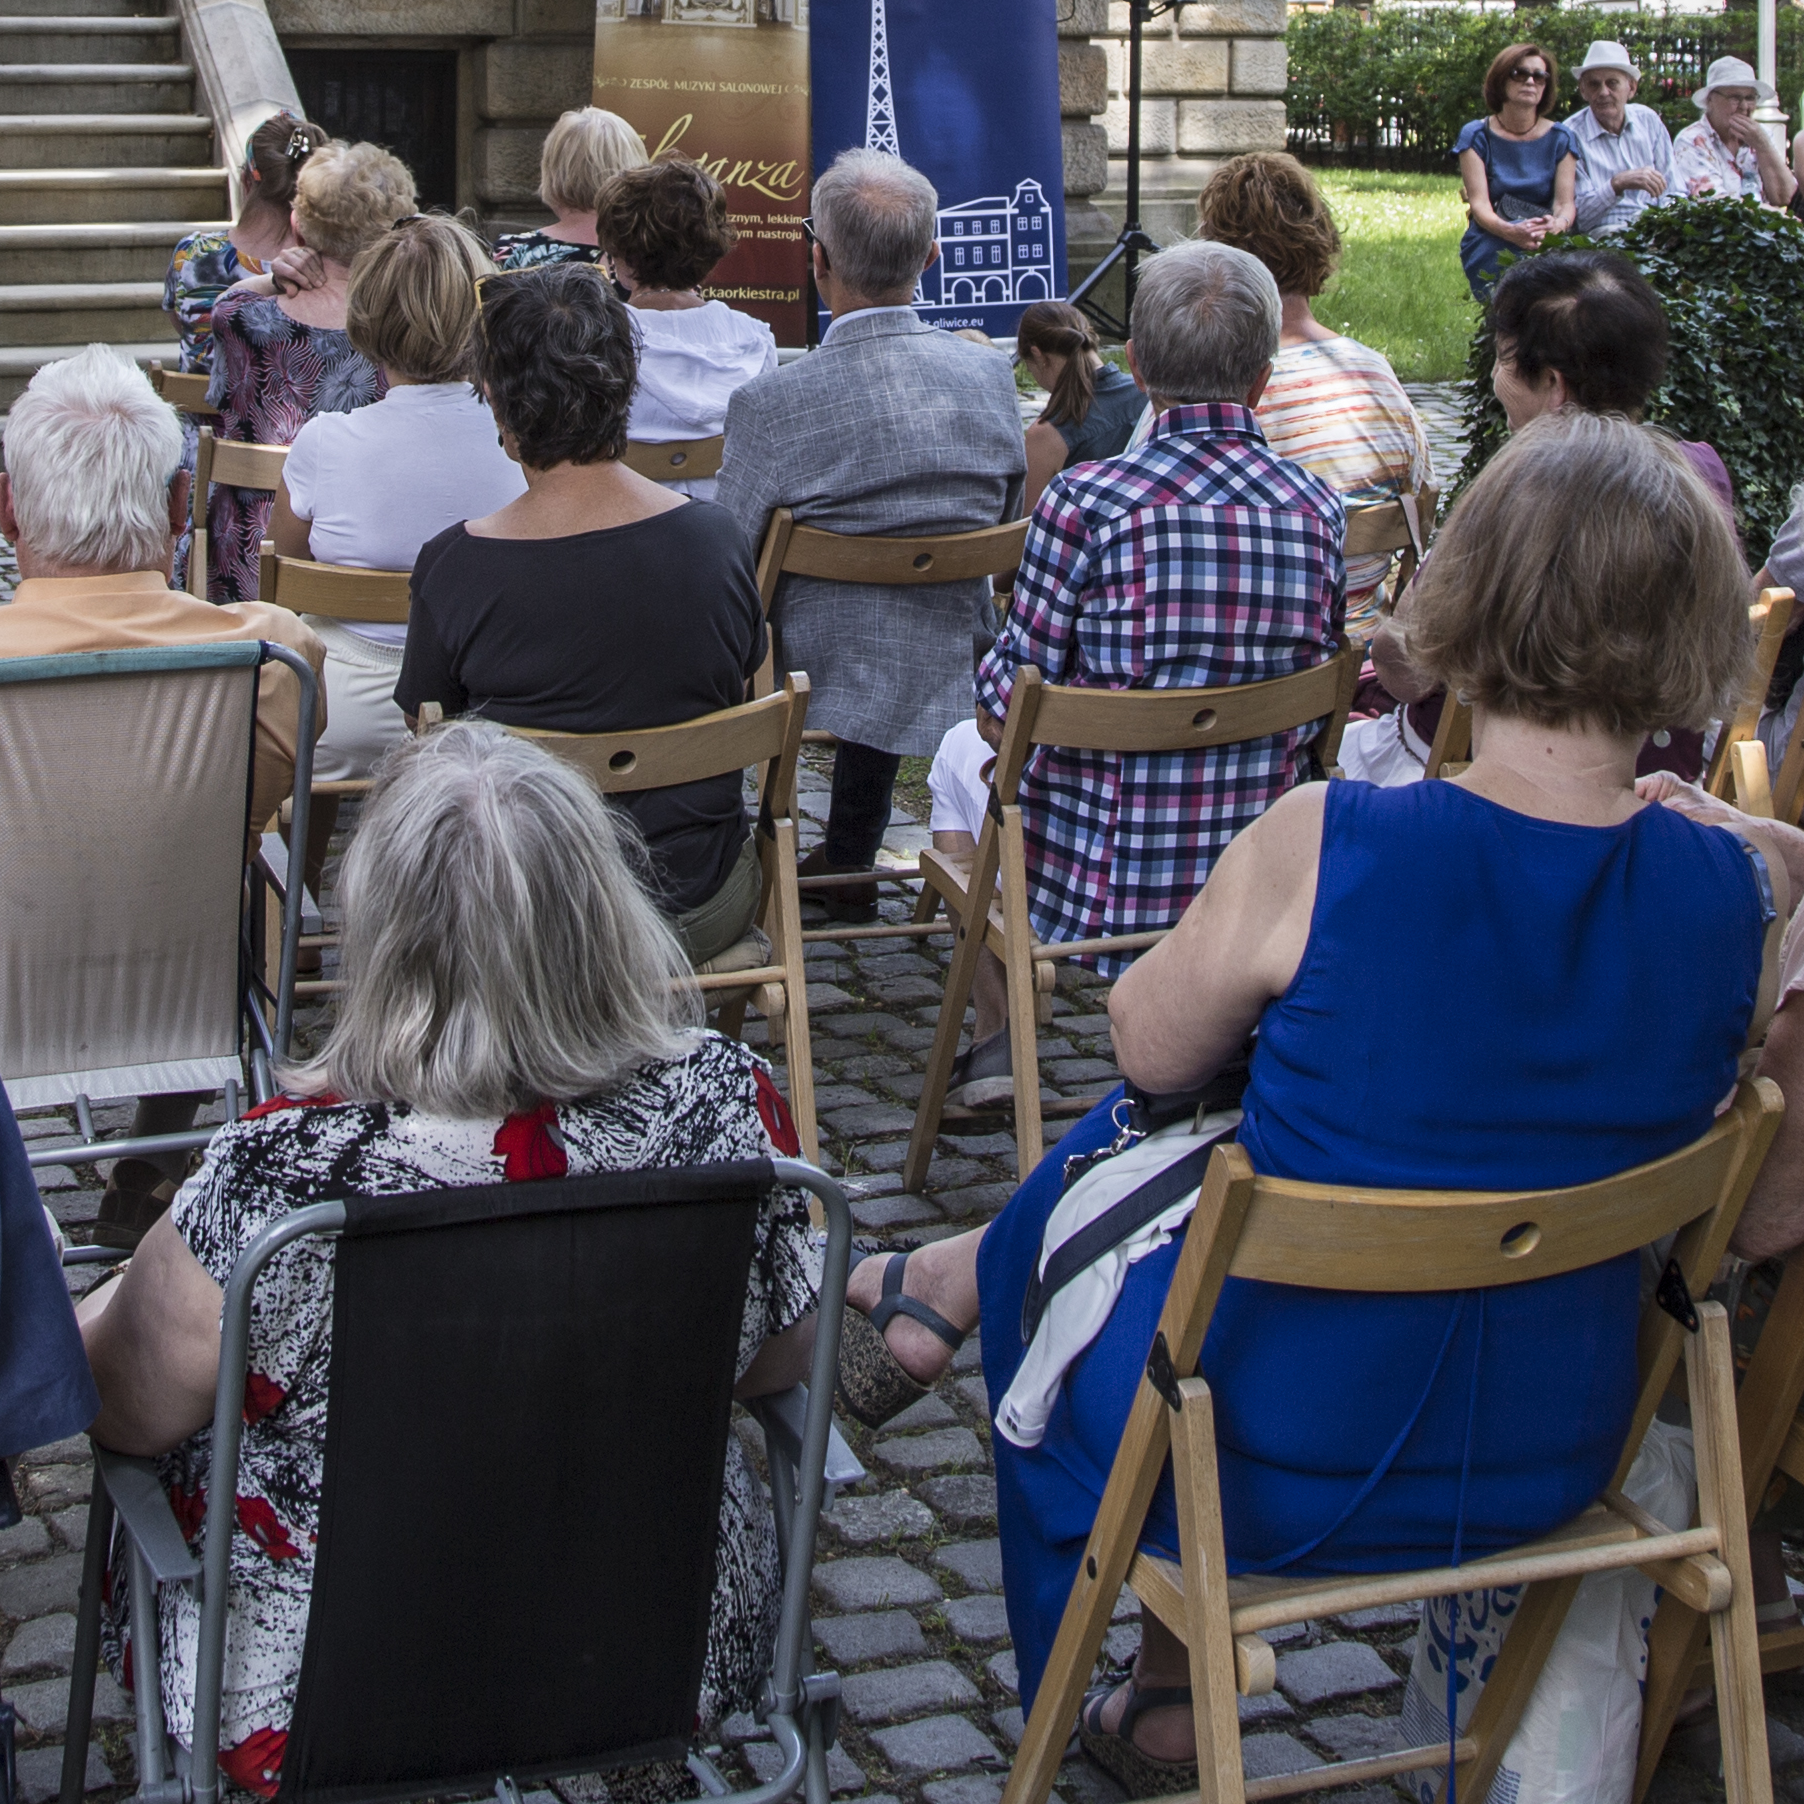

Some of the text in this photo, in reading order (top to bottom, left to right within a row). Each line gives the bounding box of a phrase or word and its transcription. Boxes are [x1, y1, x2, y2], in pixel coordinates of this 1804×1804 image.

[629, 77, 782, 94] ZESPÓŁ MUZYKI SALONOWEJ
[767, 213, 802, 224] lekkim
[757, 229, 802, 242] nastroju
[701, 286, 800, 303] ckaorkiestra.pl
